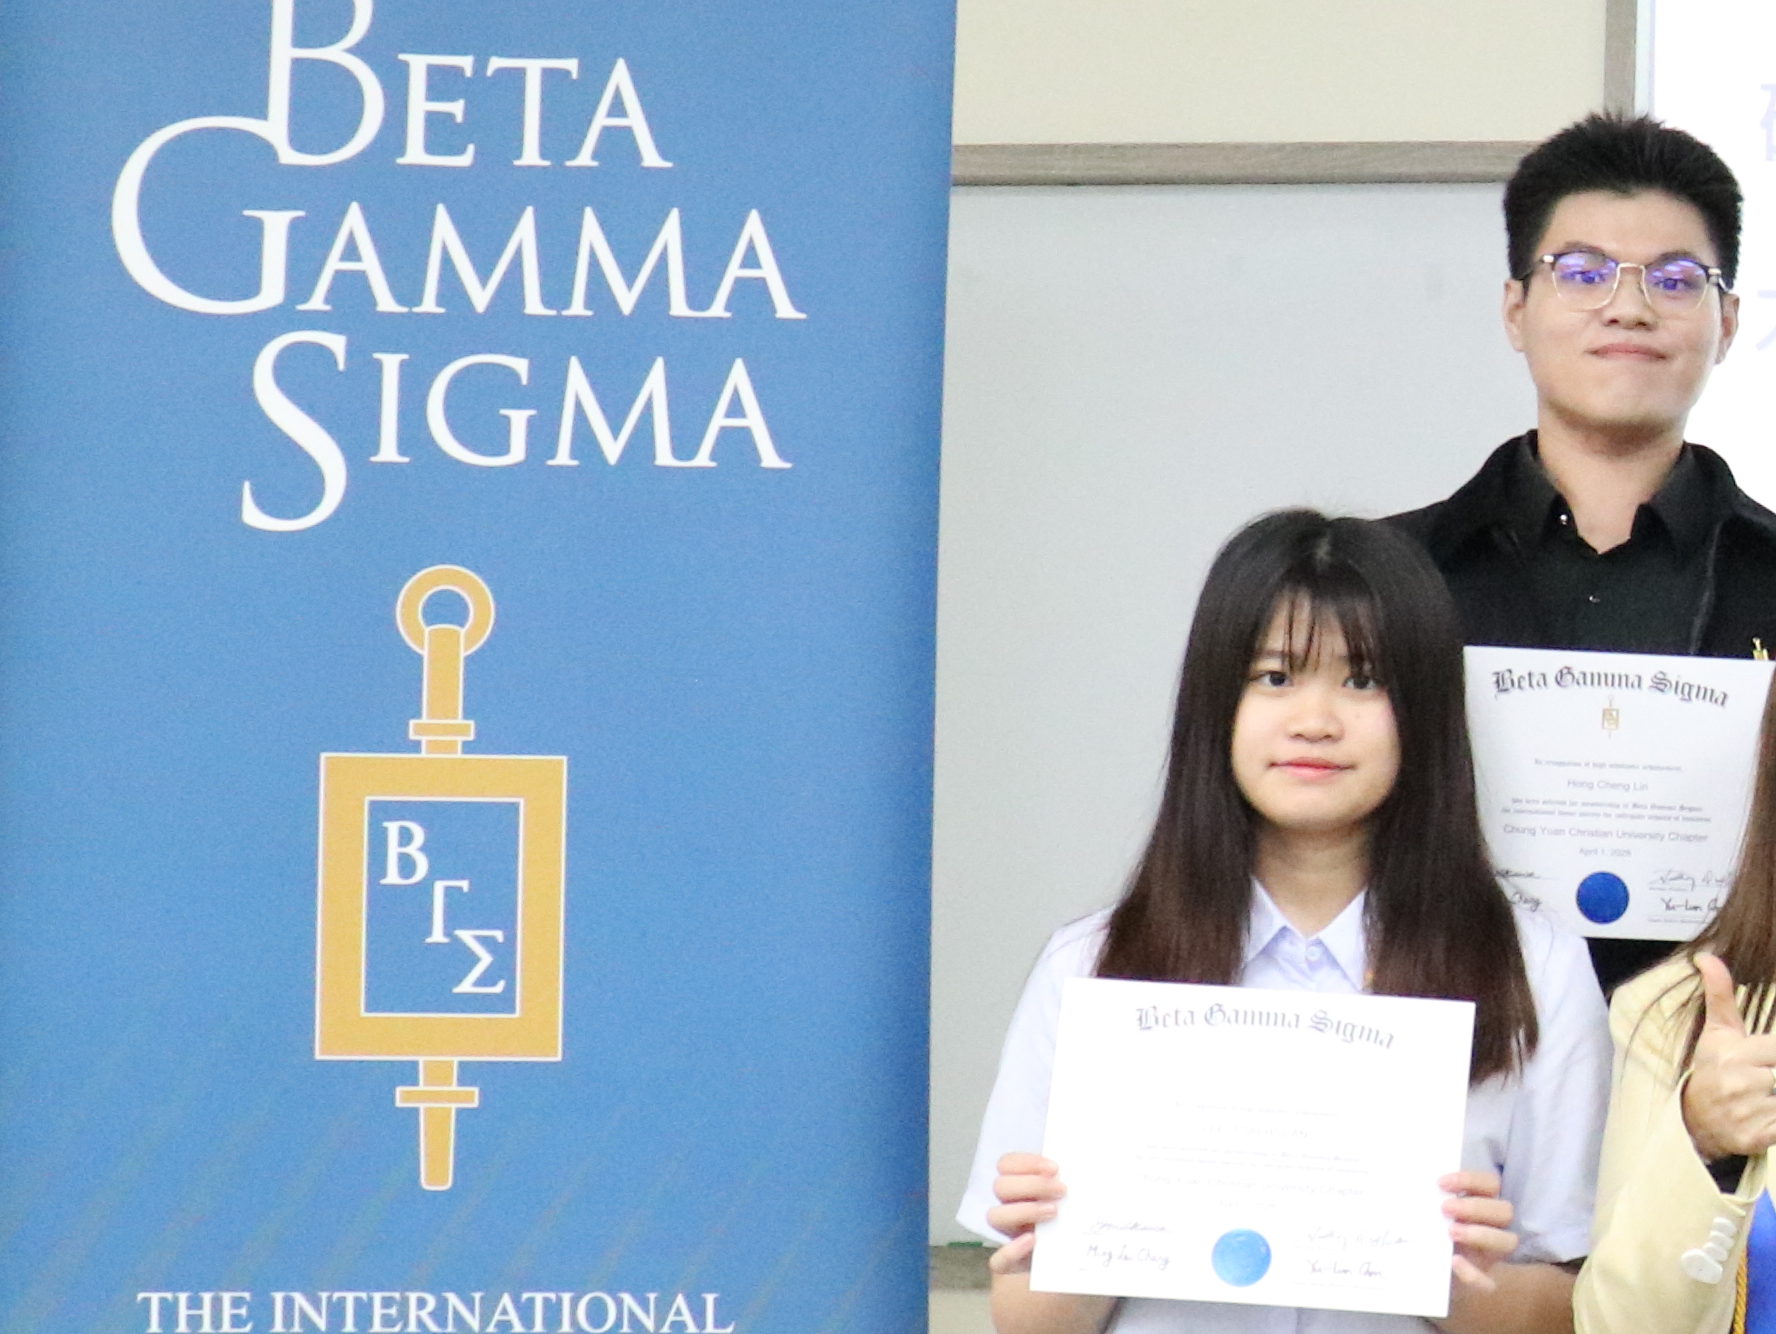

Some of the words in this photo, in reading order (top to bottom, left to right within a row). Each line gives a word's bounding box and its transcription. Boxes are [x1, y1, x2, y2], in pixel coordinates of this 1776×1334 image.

[1491, 668, 1549, 695] Beta
[1554, 665, 1643, 690] Gamma
[1648, 670, 1729, 708] Sigma
[1135, 1004, 1196, 1032] Beta
[1203, 1002, 1301, 1030] Gamma
[1306, 1009, 1395, 1050] Sigma
[136, 1291, 254, 1334] THE
